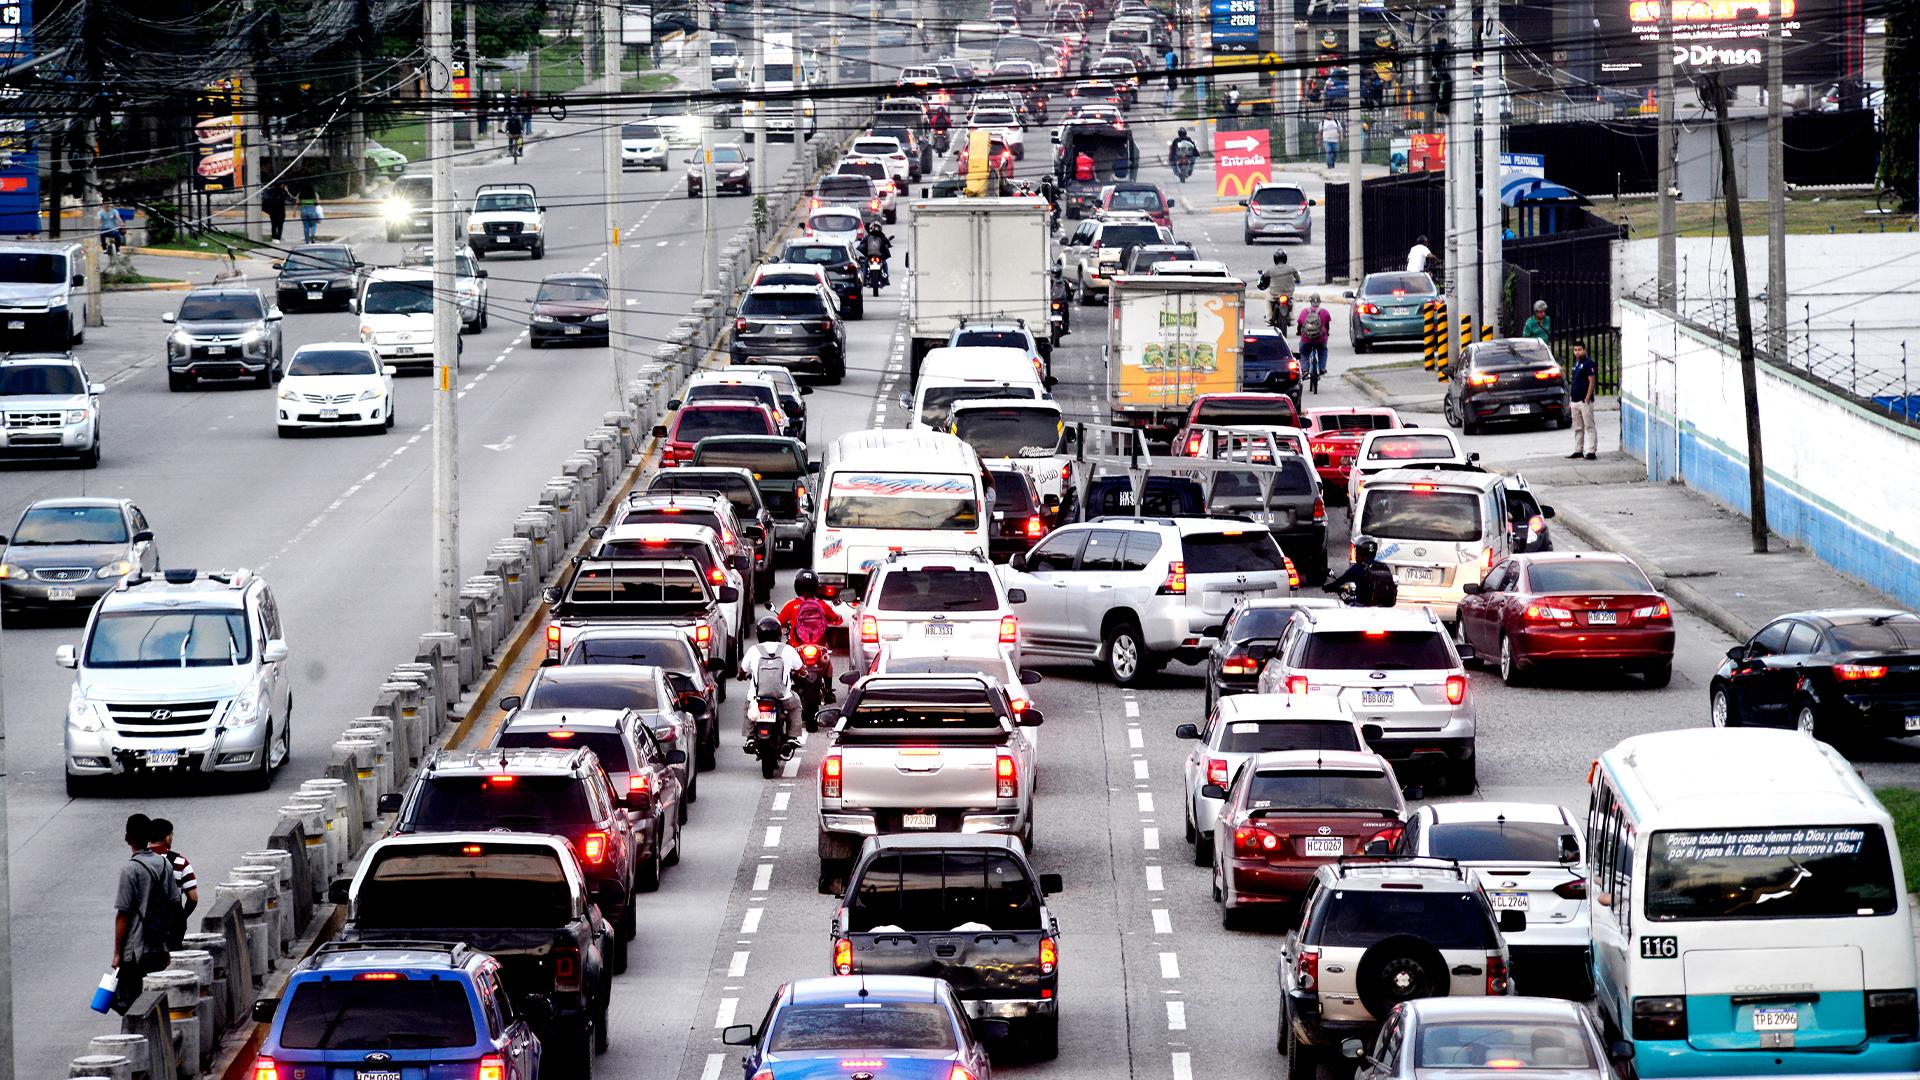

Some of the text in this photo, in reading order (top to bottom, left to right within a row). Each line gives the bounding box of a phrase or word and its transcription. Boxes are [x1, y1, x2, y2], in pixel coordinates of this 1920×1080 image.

[1221, 154, 1266, 167] Entrada
[1514, 156, 1540, 166] PEATONAL
[1667, 834, 1697, 847] Porque
[1699, 834, 1722, 844] todas
[1723, 832, 1737, 844] las
[1738, 834, 1763, 844] cosas
[1764, 832, 1791, 843] vienen
[1792, 830, 1804, 842] de
[1833, 830, 1865, 840] existen
[1323, 841, 1342, 851] 0267
[1668, 848, 1685, 860] por
[1686, 846, 1695, 858] él
[1695, 849, 1702, 860] y
[1702, 847, 1724, 859] para
[1742, 843, 1768, 856] Gloria
[1768, 845, 1790, 857] para
[1791, 843, 1827, 857] siempre
[1834, 842, 1854, 854] Dios
[1508, 896, 1528, 907] 2764
[1643, 938, 1676, 957] 116
[1734, 983, 1814, 992] COASTER
[1774, 1013, 1796, 1025] 2996
